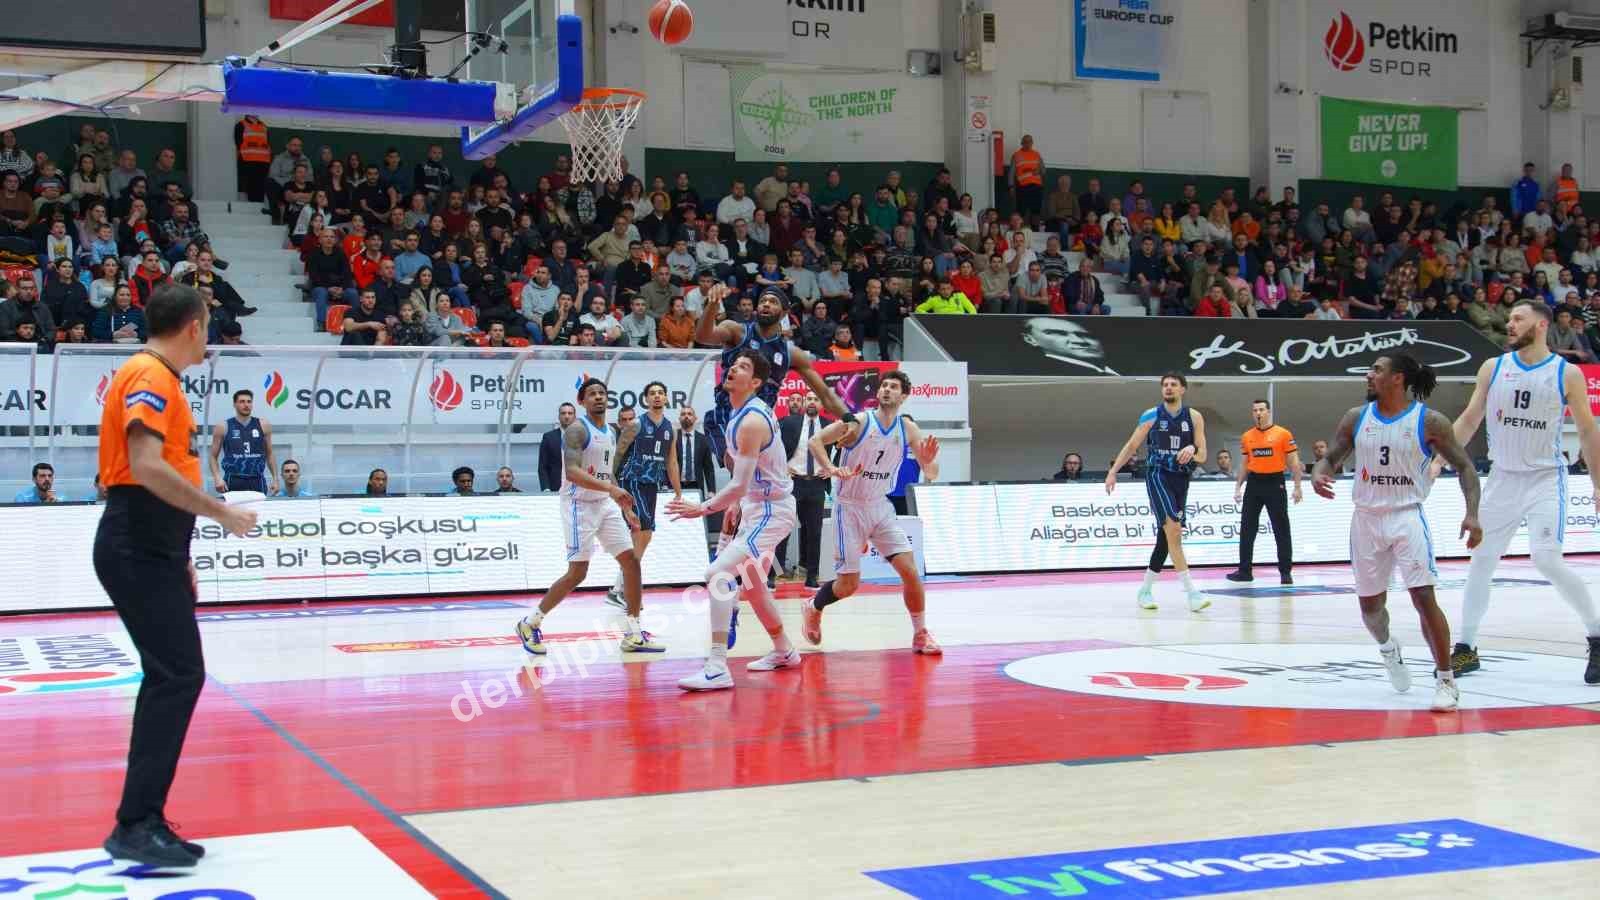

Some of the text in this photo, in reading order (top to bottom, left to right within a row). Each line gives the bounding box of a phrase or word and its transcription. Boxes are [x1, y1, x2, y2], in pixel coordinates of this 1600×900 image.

[1093, 8, 1146, 23] EUROPE
[1149, 14, 1174, 25] CUP
[1368, 22, 1458, 54] Petkim
[1368, 58, 1431, 77] SPOR
[808, 88, 897, 109] CHILDREN OF
[816, 108, 843, 121] THE
[847, 102, 892, 118] NORTH
[1358, 113, 1421, 133] NEVER
[1349, 132, 1429, 153] GIVE UP!
[296, 388, 392, 410] SOCAR
[471, 399, 522, 410] SPOR
[1513, 389, 1532, 410] 19
[1169, 435, 1181, 449] 10
[876, 450, 885, 465] 7
[1379, 445, 1390, 466] 3
[1051, 503, 1151, 518] Basketbo
[337, 516, 478, 540] coşkusu
[1029, 522, 1120, 543] Aliağa'da
[1125, 522, 1145, 538] bi'
[276, 547, 309, 567] bi'
[321, 545, 422, 570] başka
[433, 541, 520, 568] güzel!
[1103, 842, 1430, 883] finans
